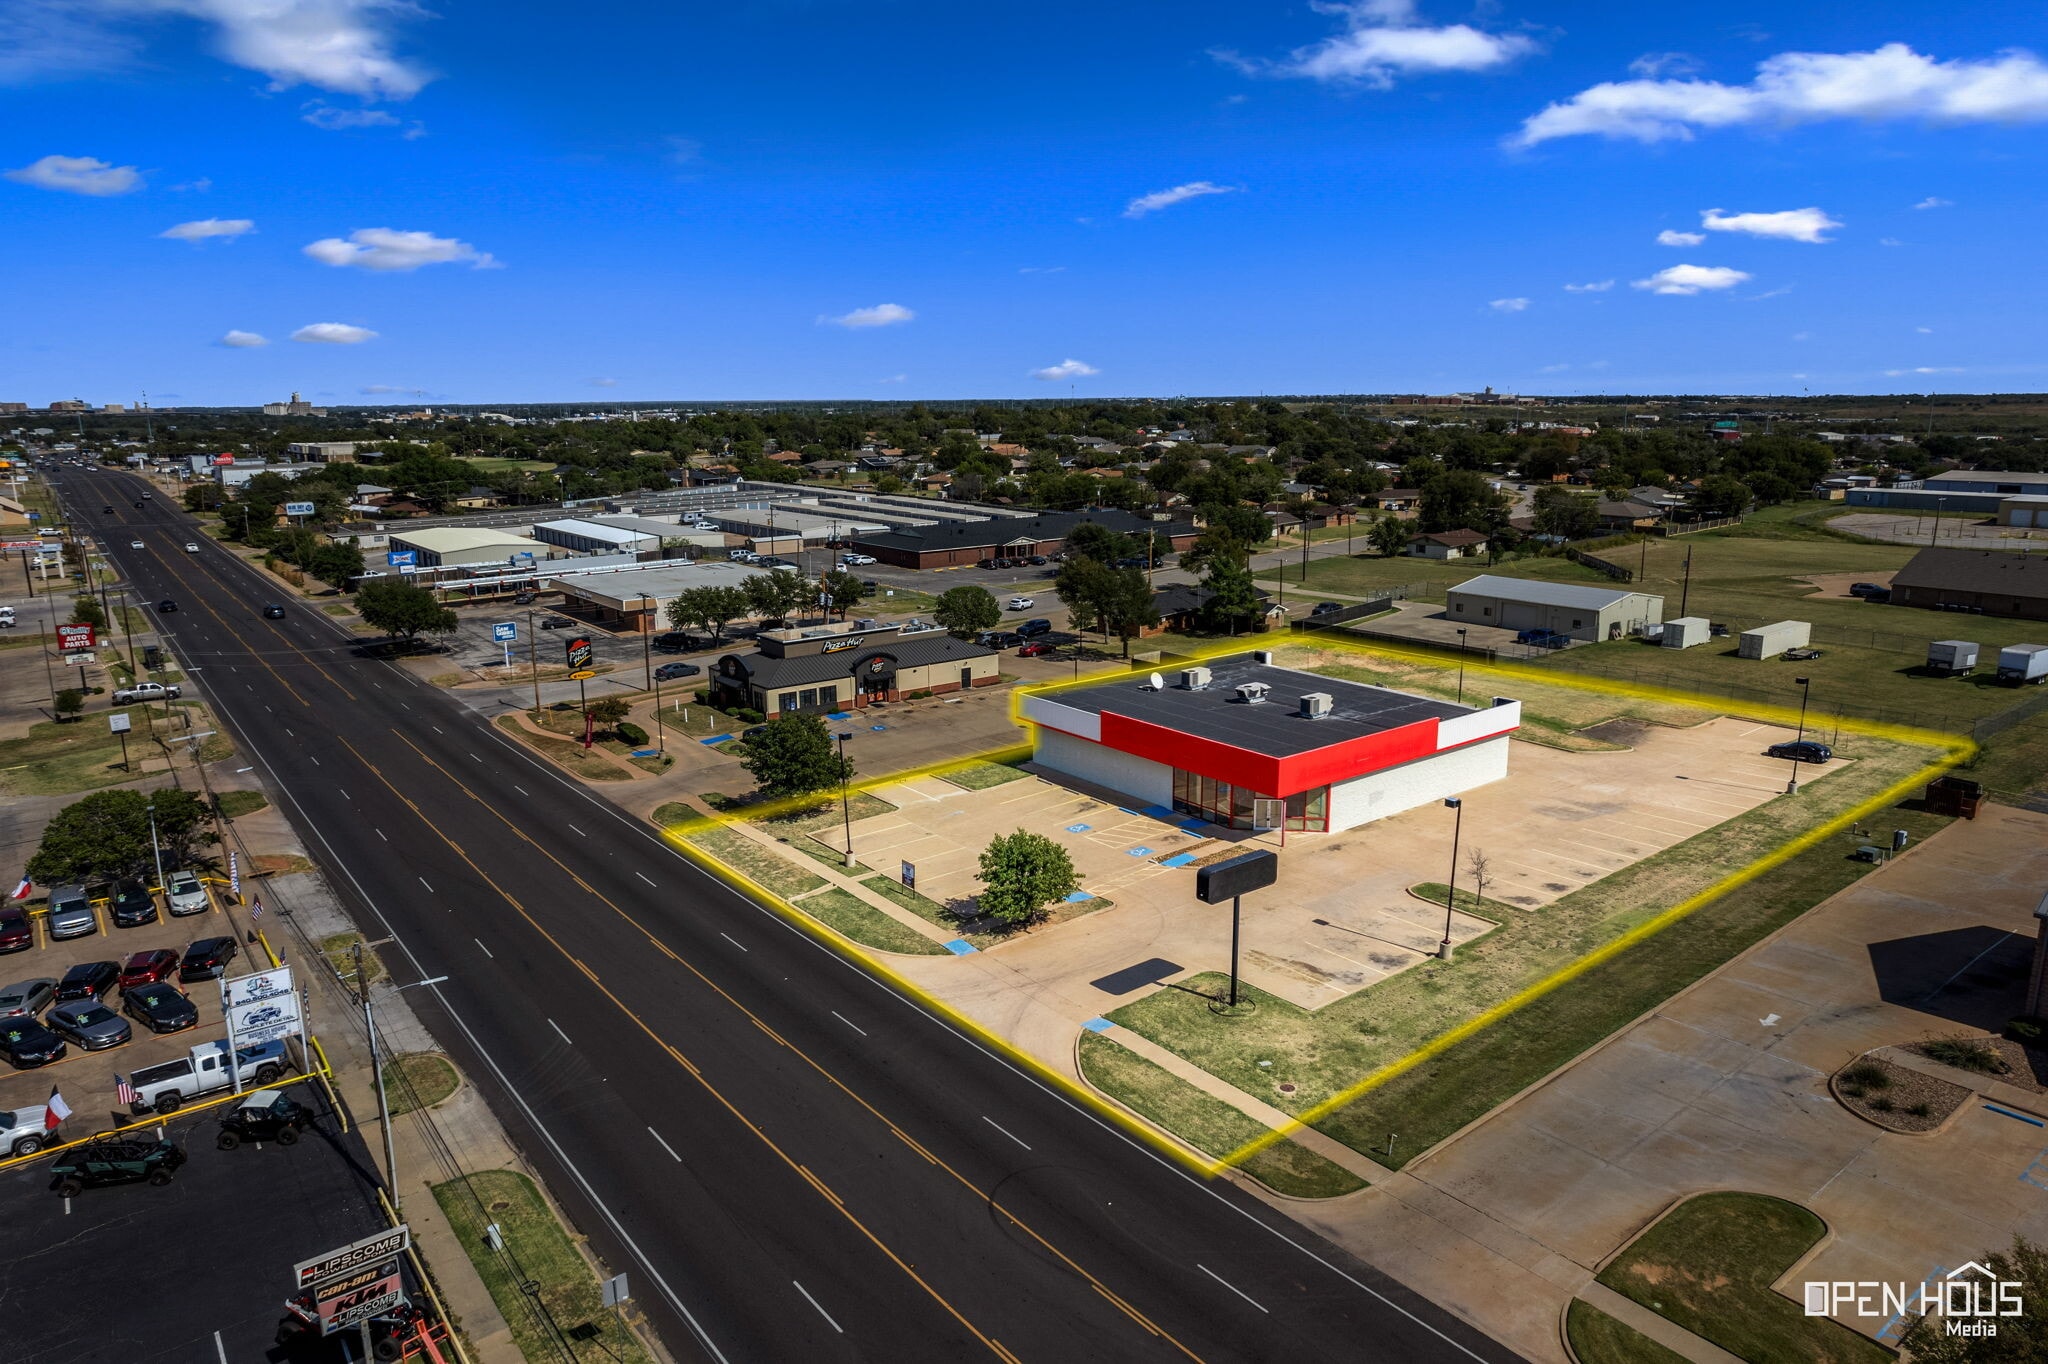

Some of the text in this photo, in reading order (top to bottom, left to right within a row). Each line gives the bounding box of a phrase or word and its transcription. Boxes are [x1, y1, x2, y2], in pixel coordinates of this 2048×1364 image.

[64, 640, 91, 648] PARTS
[66, 634, 88, 642] AUTO
[846, 637, 864, 647] Hut
[574, 652, 589, 664] Hut
[236, 1015, 295, 1033] COMPLETE DETAIL
[247, 1027, 271, 1039] BUSINESS
[271, 1025, 287, 1034] HOURS
[313, 1235, 401, 1275] LIPSCOMB
[313, 1243, 400, 1280] POWERSPORTS
[317, 1270, 378, 1298] can-am
[333, 1282, 388, 1314] KTM
[338, 1293, 397, 1322] LIPSCOMB
